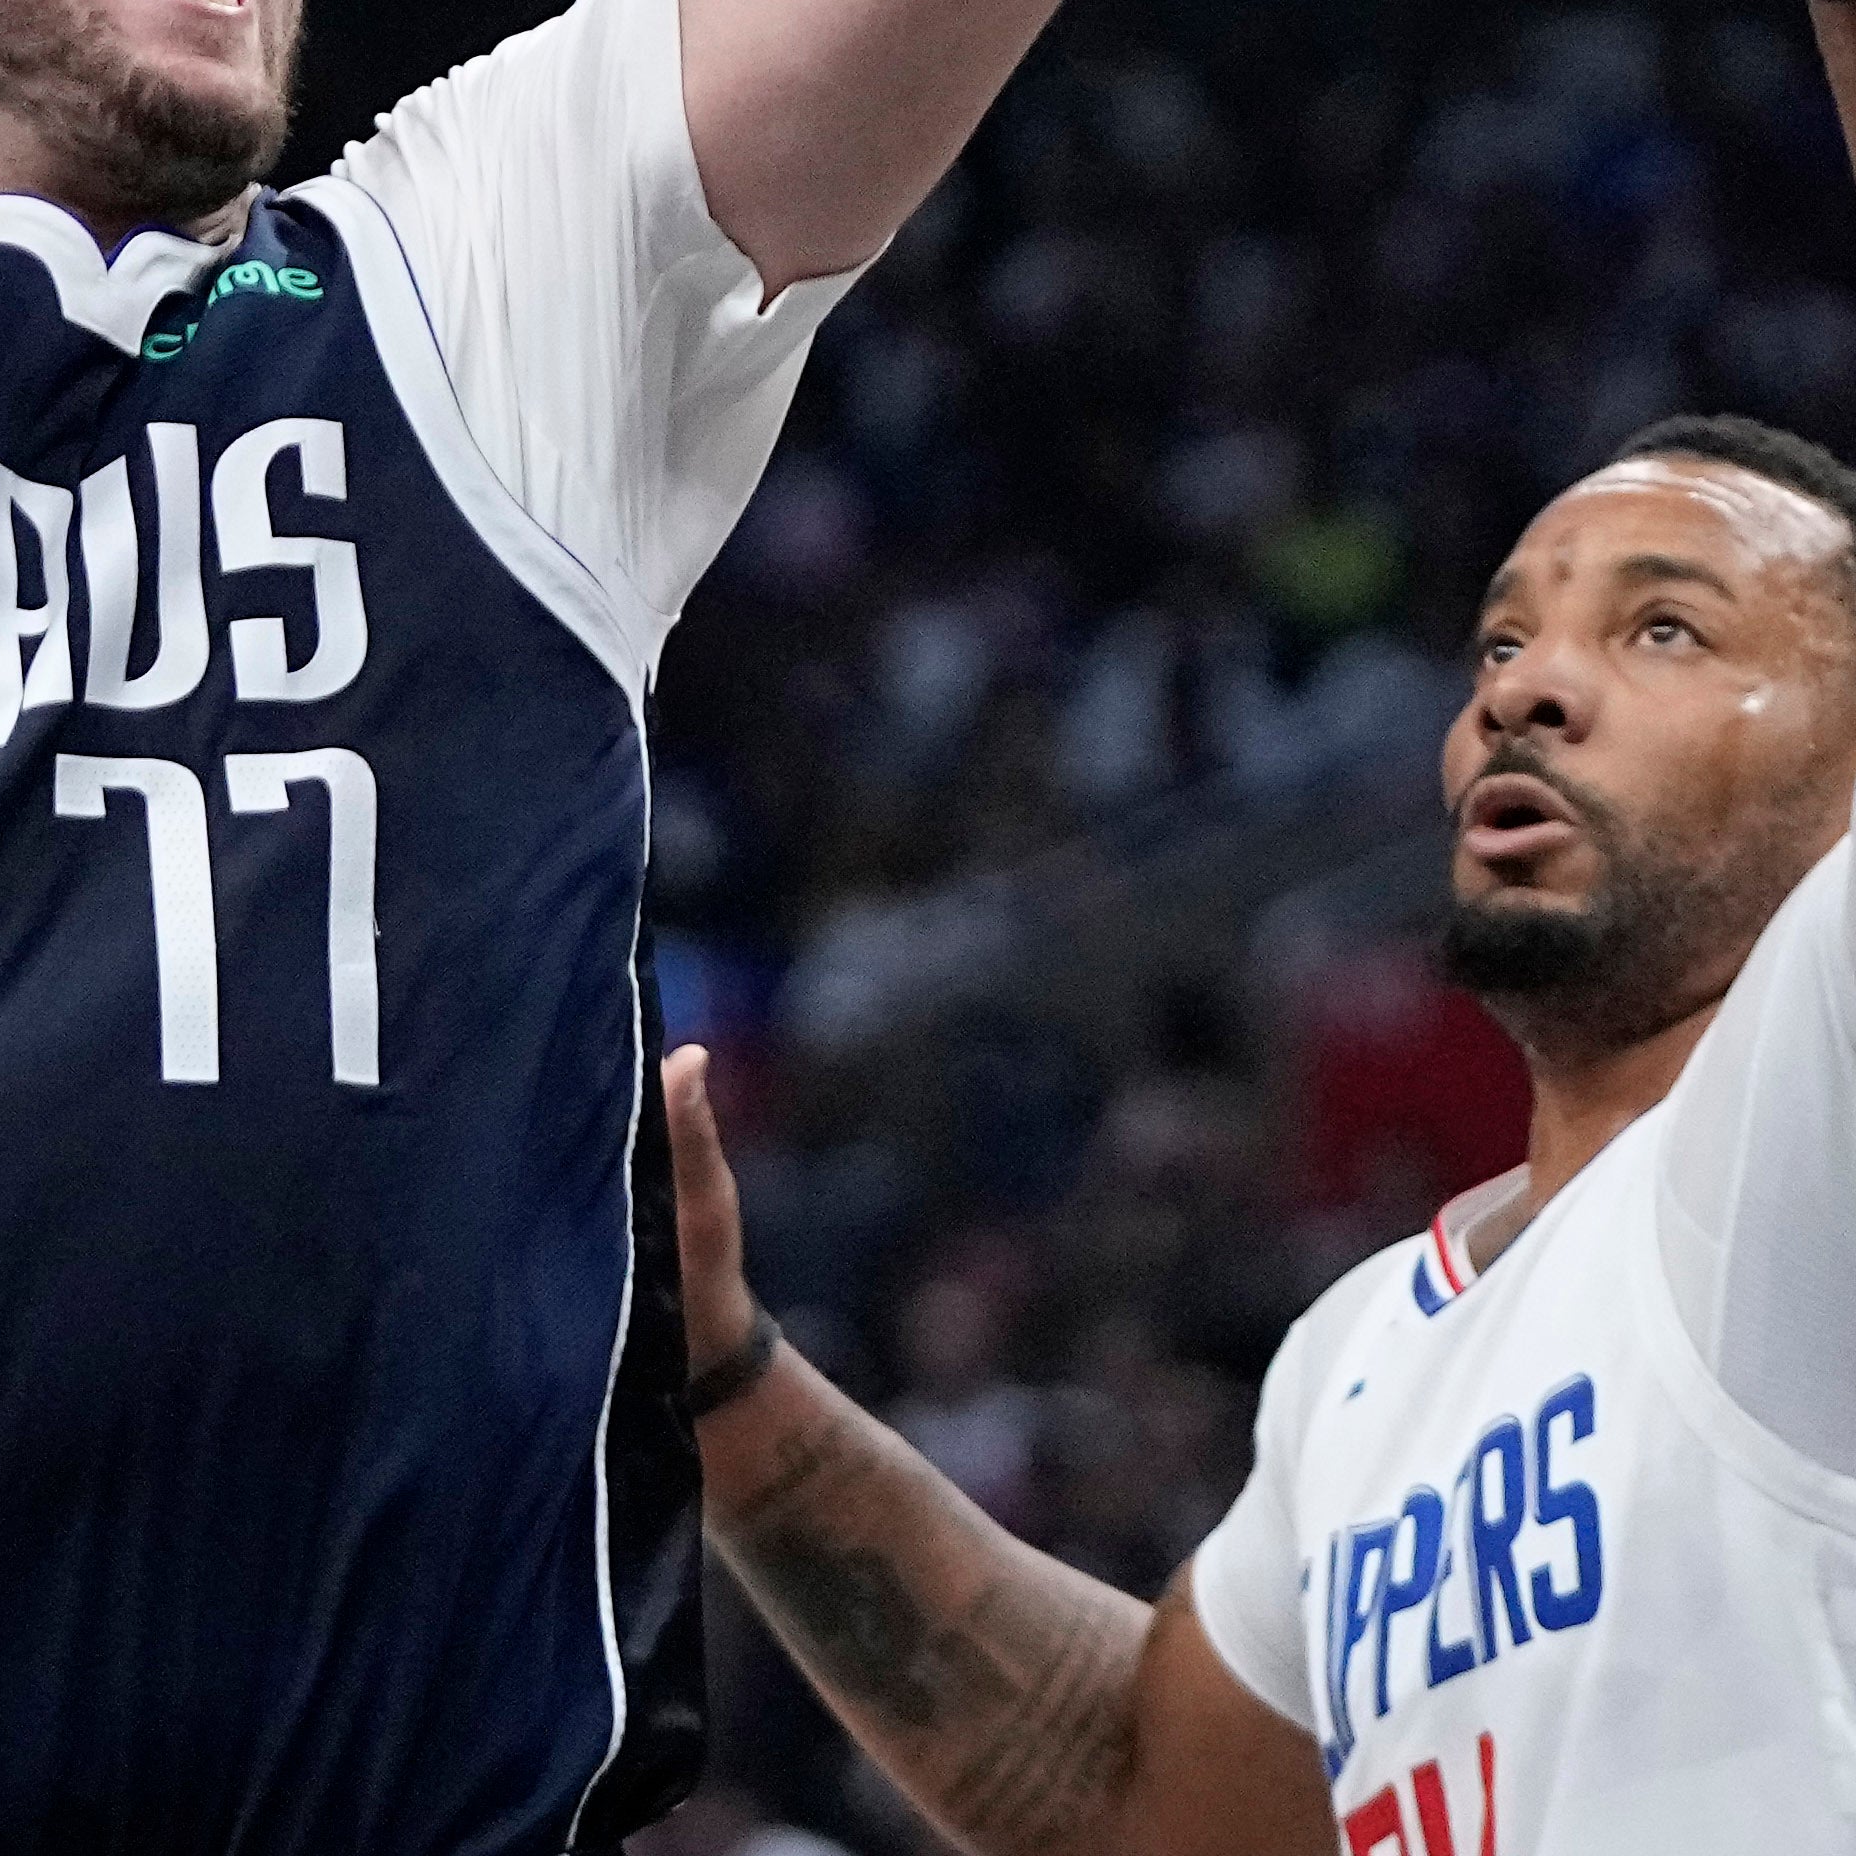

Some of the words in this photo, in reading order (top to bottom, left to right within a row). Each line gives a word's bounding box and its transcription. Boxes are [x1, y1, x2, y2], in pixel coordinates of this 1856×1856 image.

[142, 259, 325, 361] cme
[54, 747, 380, 1085] 77
[1304, 1372, 1603, 1784] IPPERS
